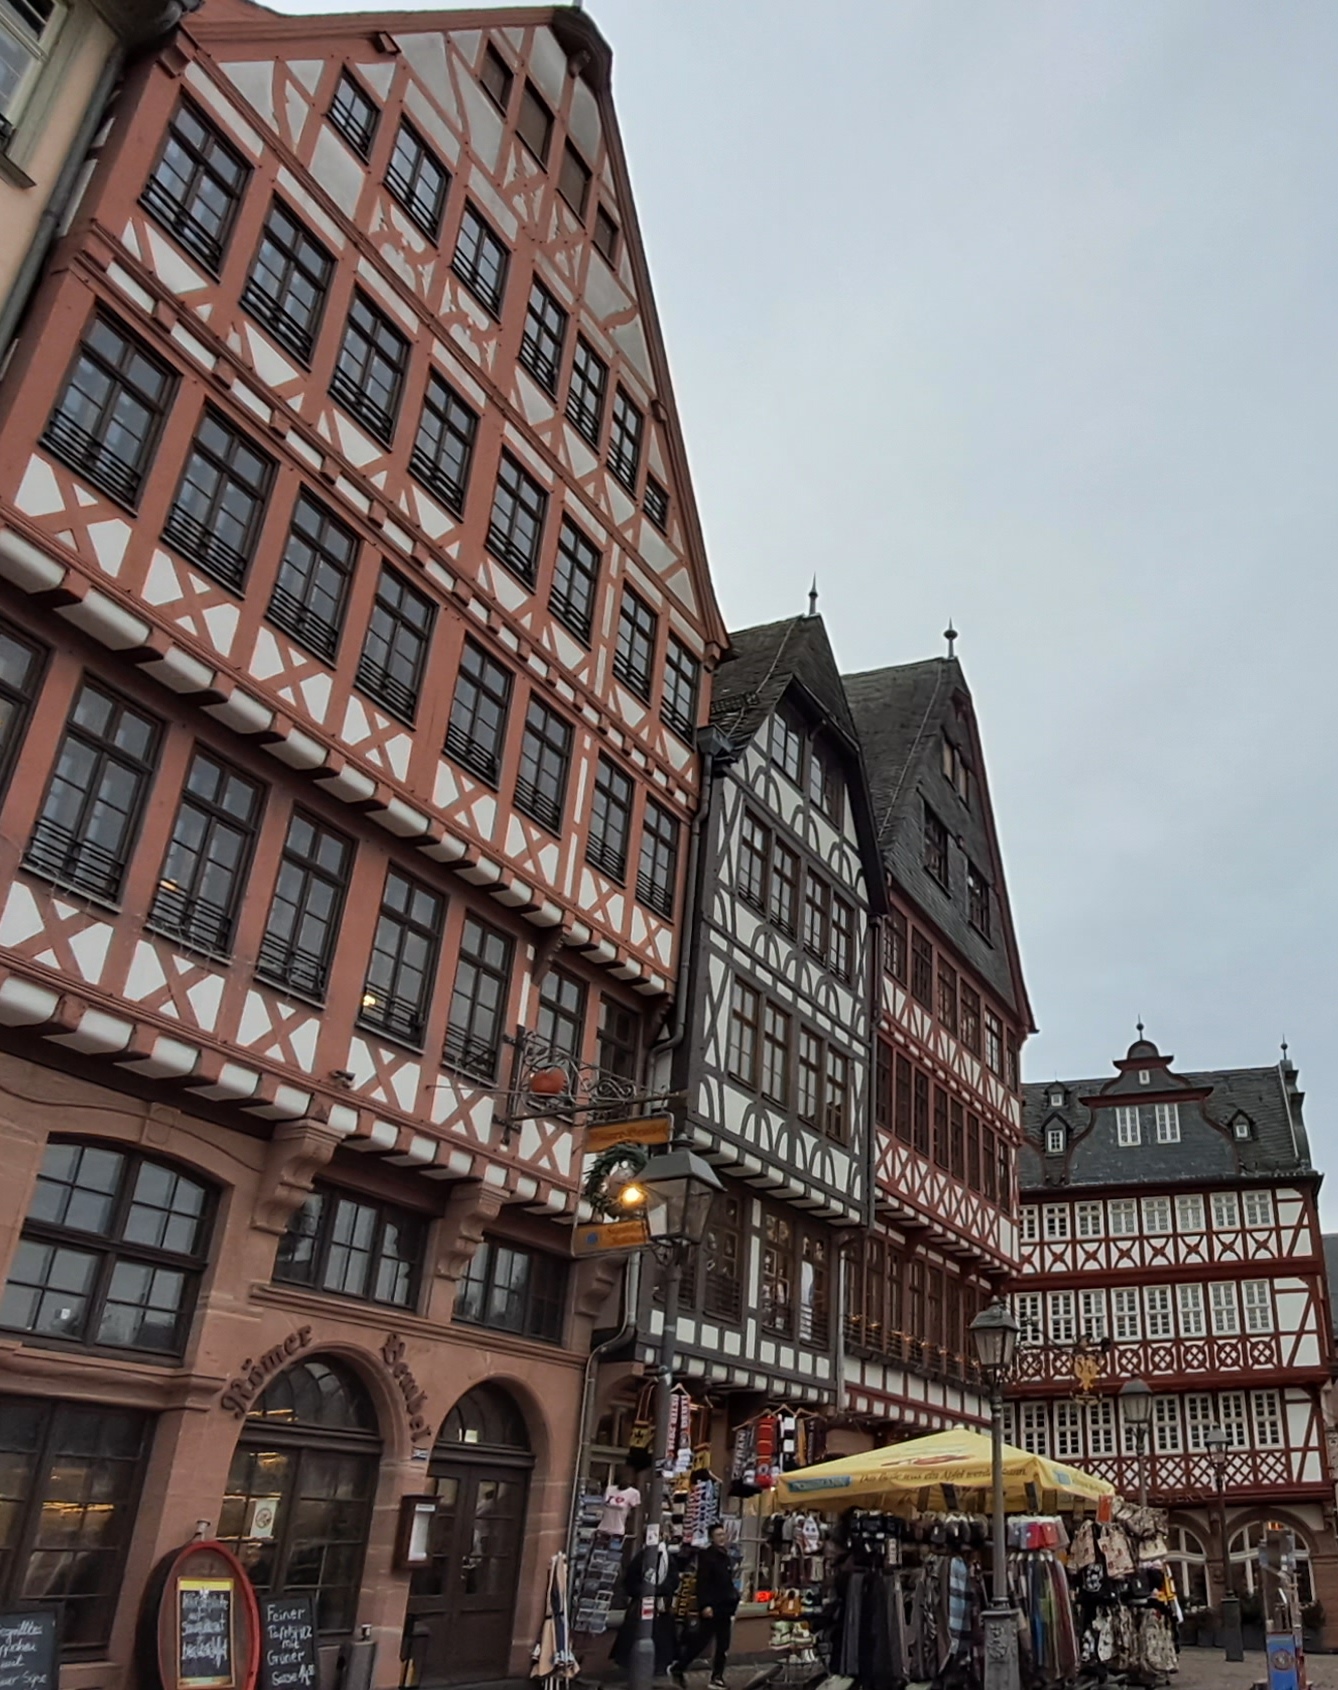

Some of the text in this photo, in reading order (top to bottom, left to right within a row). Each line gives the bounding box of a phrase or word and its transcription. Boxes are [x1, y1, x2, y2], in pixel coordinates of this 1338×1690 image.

[221, 1324, 432, 1443] Römer Bembel
[267, 1604, 306, 1622] Feiner
